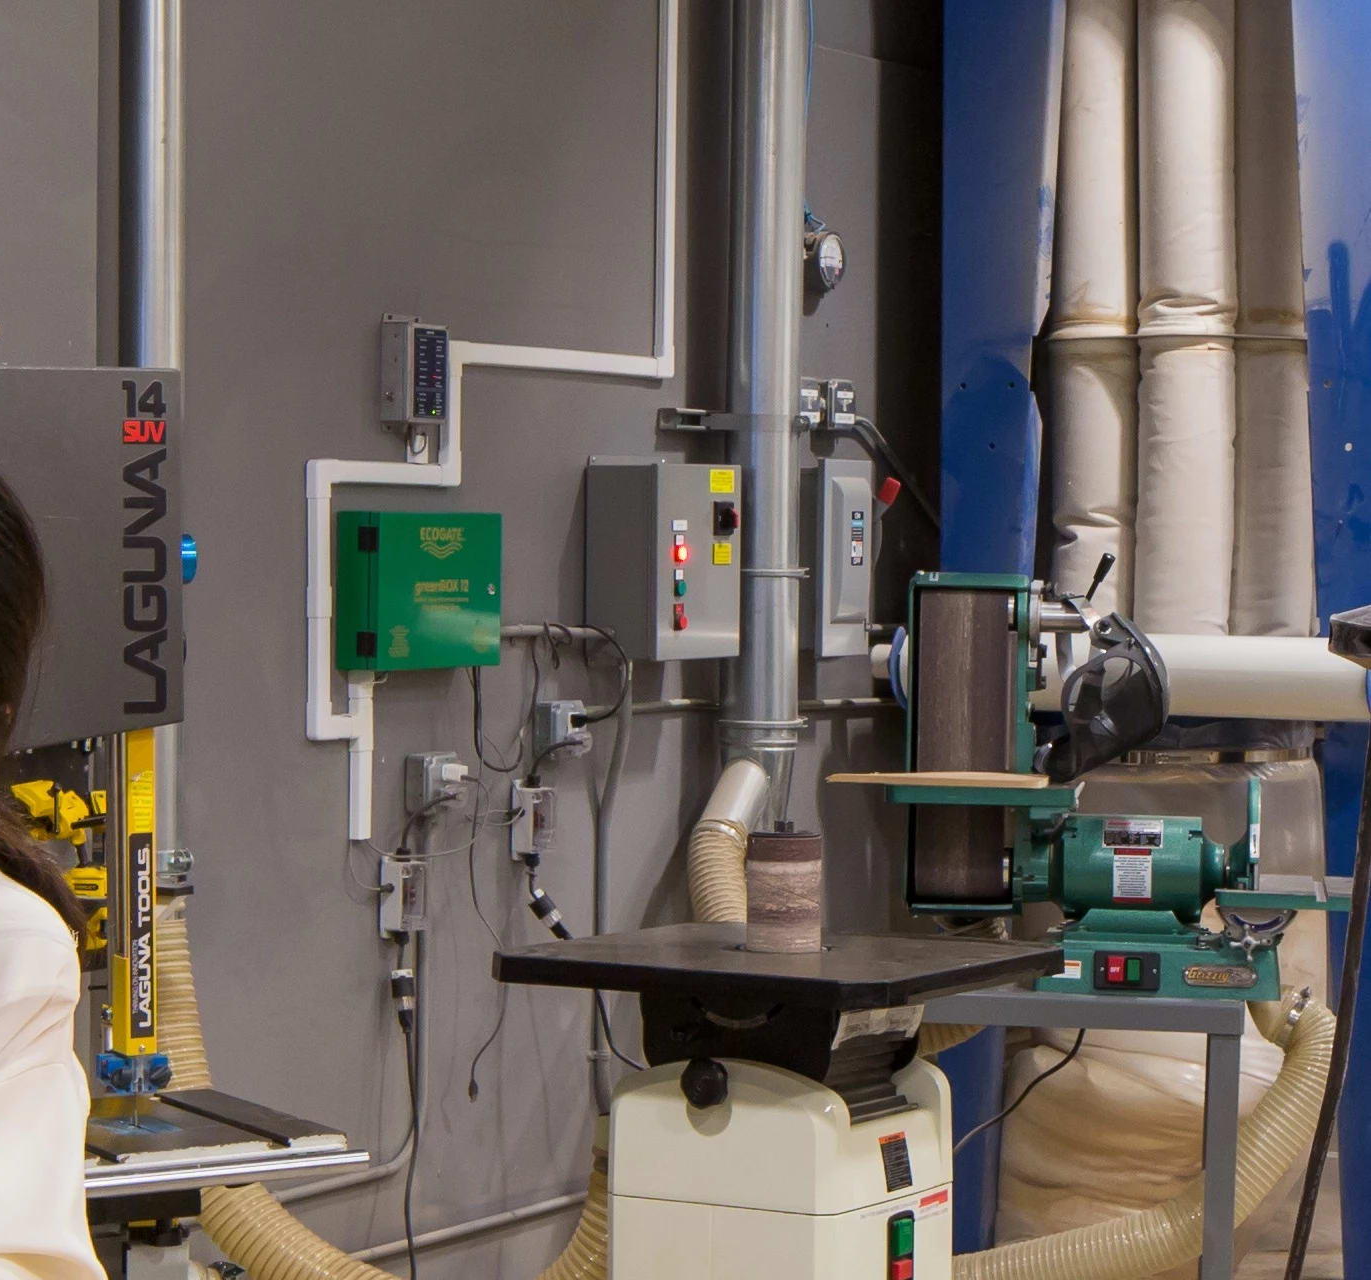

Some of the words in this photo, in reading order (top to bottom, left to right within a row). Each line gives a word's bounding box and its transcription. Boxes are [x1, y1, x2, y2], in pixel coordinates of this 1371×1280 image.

[122, 380, 167, 418] 14
[123, 420, 166, 444] SUV
[420, 527, 464, 541] ECOGATE
[122, 448, 168, 716] LAGUNA
[137, 846, 151, 928] TOOLS
[138, 932, 152, 1028] LAGUNA
